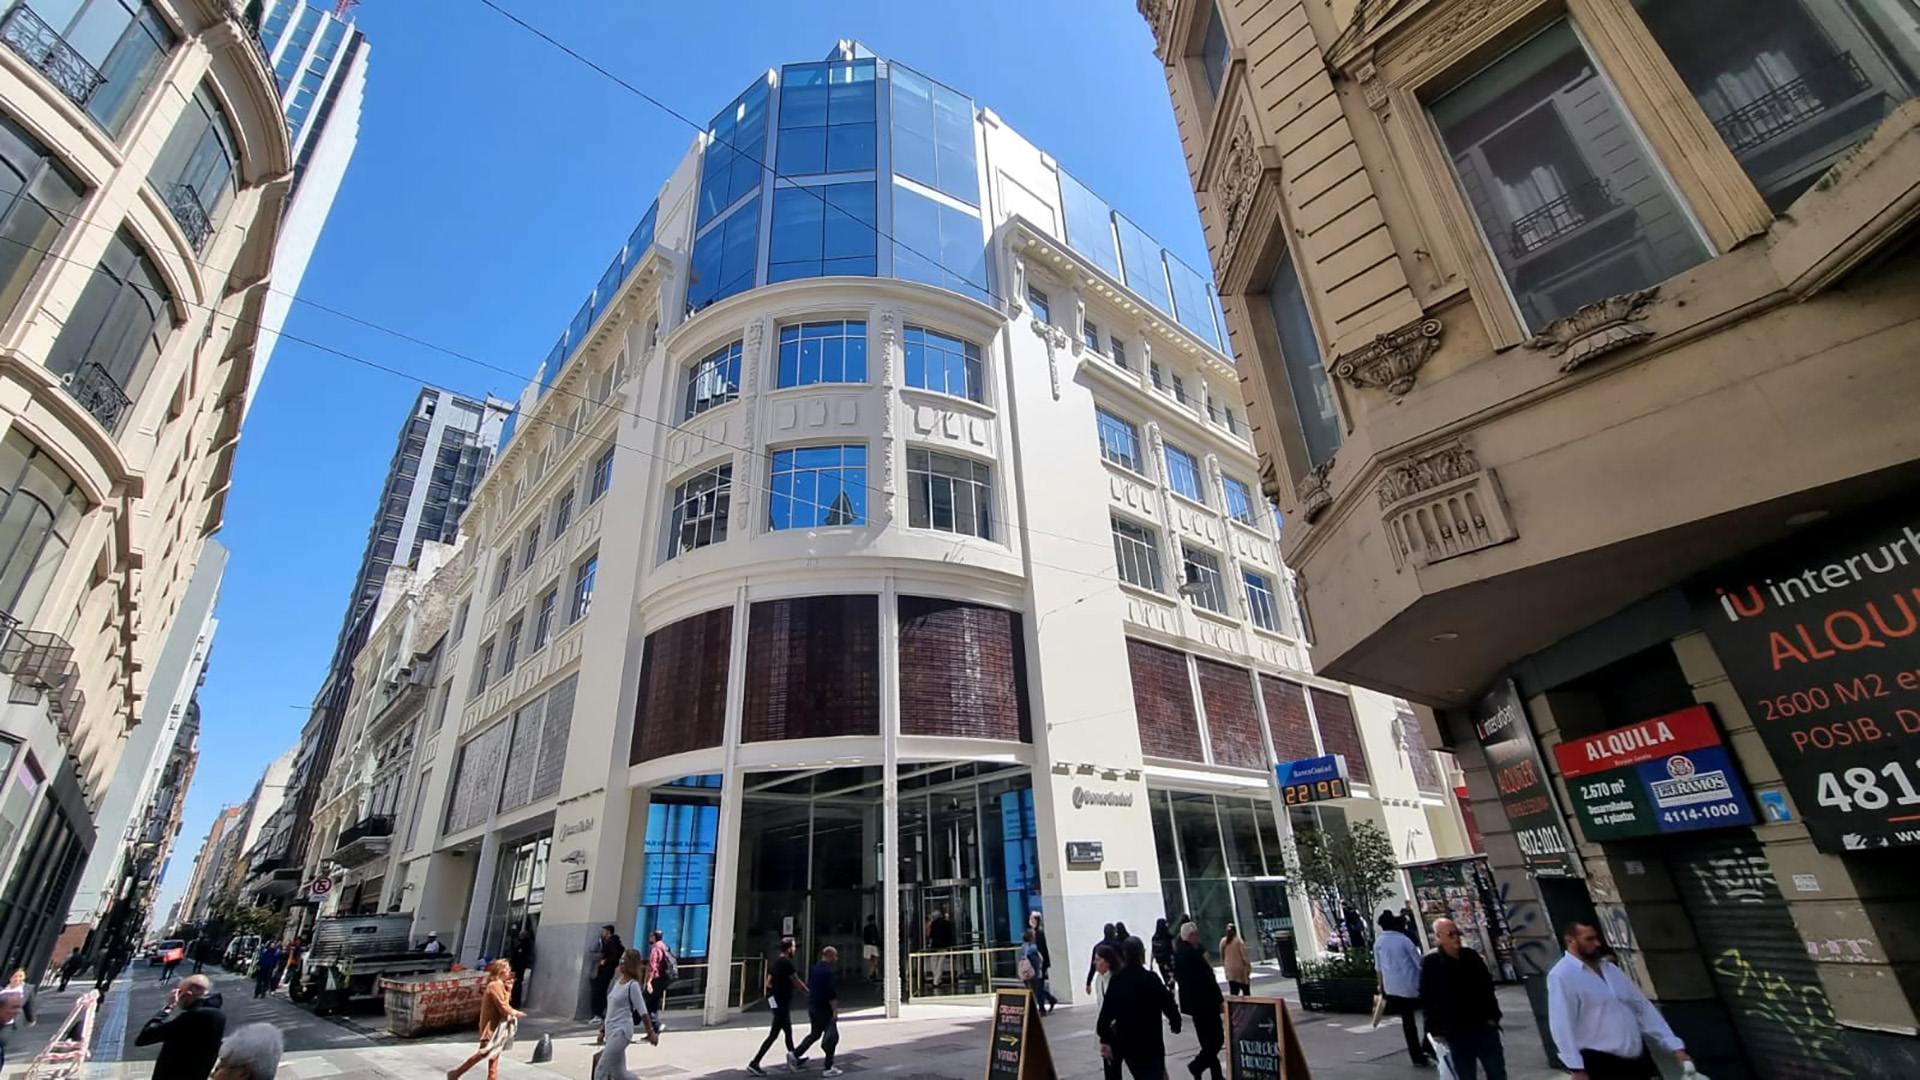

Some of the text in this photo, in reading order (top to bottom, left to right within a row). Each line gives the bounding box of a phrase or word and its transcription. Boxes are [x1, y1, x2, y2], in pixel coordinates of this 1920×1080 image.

[1769, 587, 1920, 671] ALQU
[1758, 669, 1920, 720] 2600 M2 e
[1585, 721, 1675, 761] ALQUILA
[1286, 784, 1308, 804] 22
[1580, 781, 1610, 800] 2.670
[1817, 757, 1920, 812] 481
[1663, 803, 1740, 823] 4114-1000
